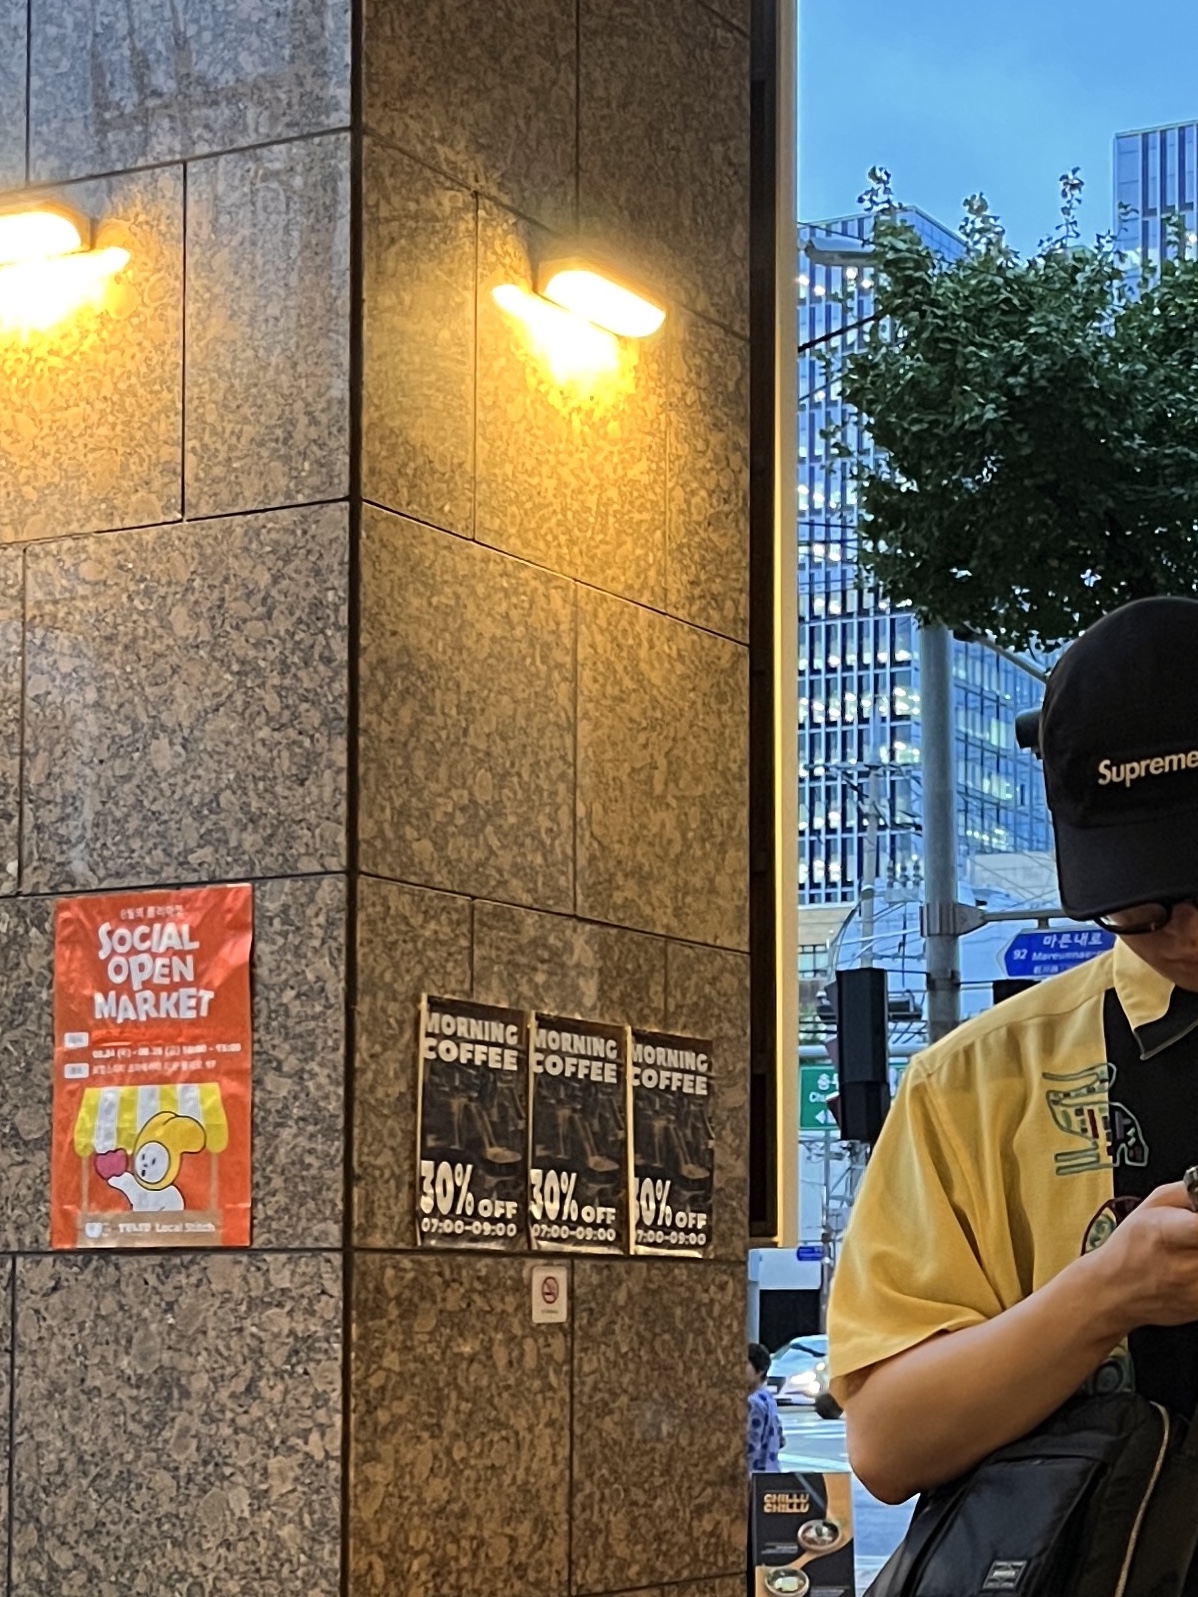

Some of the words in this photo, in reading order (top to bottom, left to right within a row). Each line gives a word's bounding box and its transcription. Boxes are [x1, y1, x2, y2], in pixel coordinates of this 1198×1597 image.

[98, 922, 199, 960] SOCIAL
[1013, 949, 1028, 960] 92
[1043, 932, 1103, 949] 마른내로
[107, 953, 194, 991] OPEN
[94, 987, 215, 1024] MARKET
[425, 1012, 518, 1045] MORNING
[534, 1028, 618, 1060] MORNING
[424, 1037, 518, 1071] COFFEE
[532, 1052, 618, 1084] COFFEE
[632, 1043, 708, 1073] MORNING
[632, 1066, 708, 1096] COFFEE
[420, 1160, 475, 1216] 30%
[478, 1199, 518, 1219] OFF
[529, 1168, 579, 1222] 30%
[581, 1205, 617, 1225] OFF
[421, 1217, 518, 1237] 07:00-09:00
[532, 1223, 616, 1242] 07:00-09:00
[675, 1211, 707, 1229] OFF
[636, 1229, 707, 1246] 7:00-09:00
